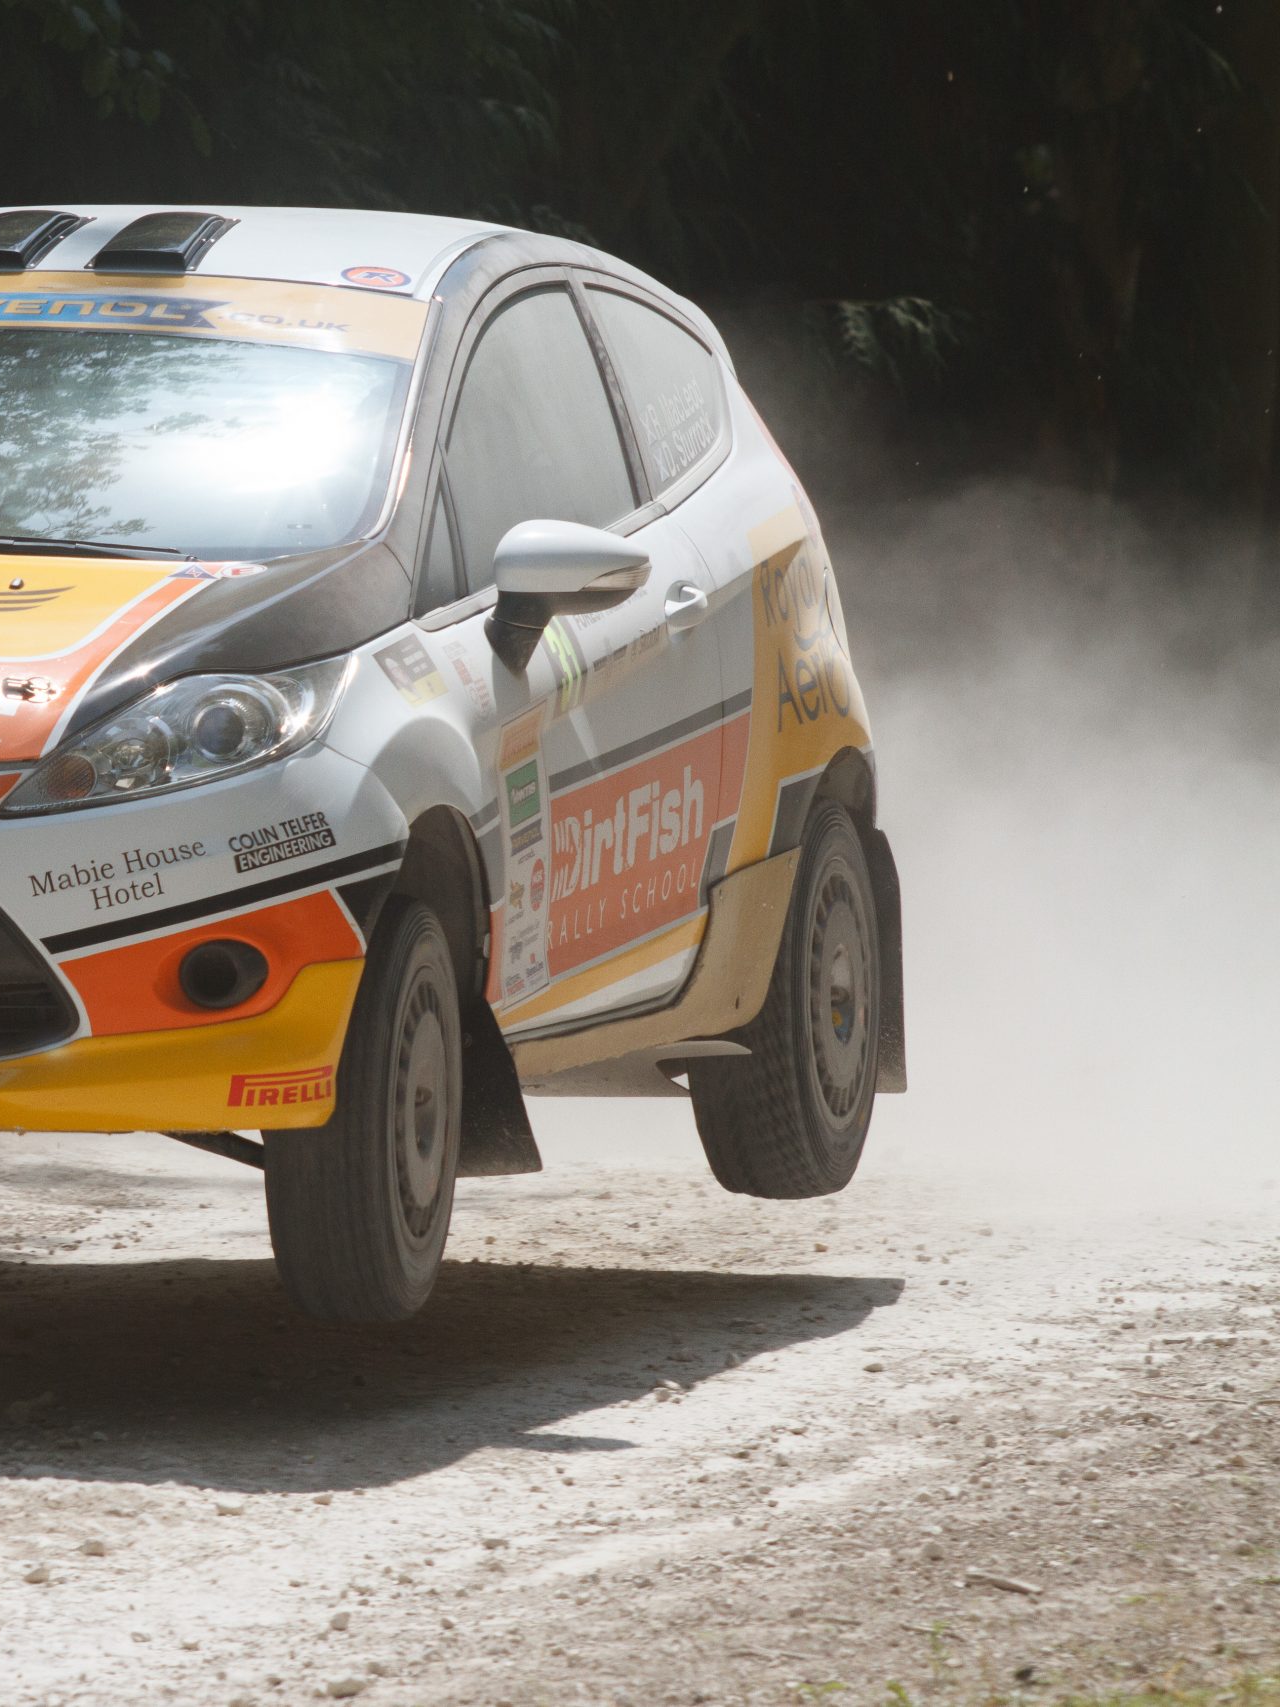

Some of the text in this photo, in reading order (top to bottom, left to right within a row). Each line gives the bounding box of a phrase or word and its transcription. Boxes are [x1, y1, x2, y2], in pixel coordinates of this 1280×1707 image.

[227, 811, 331, 853] COLIN TELFER
[238, 829, 333, 872] ENGINEERING
[27, 840, 207, 898] Mabie House
[91, 872, 166, 911] Hotel
[546, 896, 607, 950] RALLY
[620, 858, 697, 920] SCHOOL
[227, 1065, 333, 1108] PIRELLI
